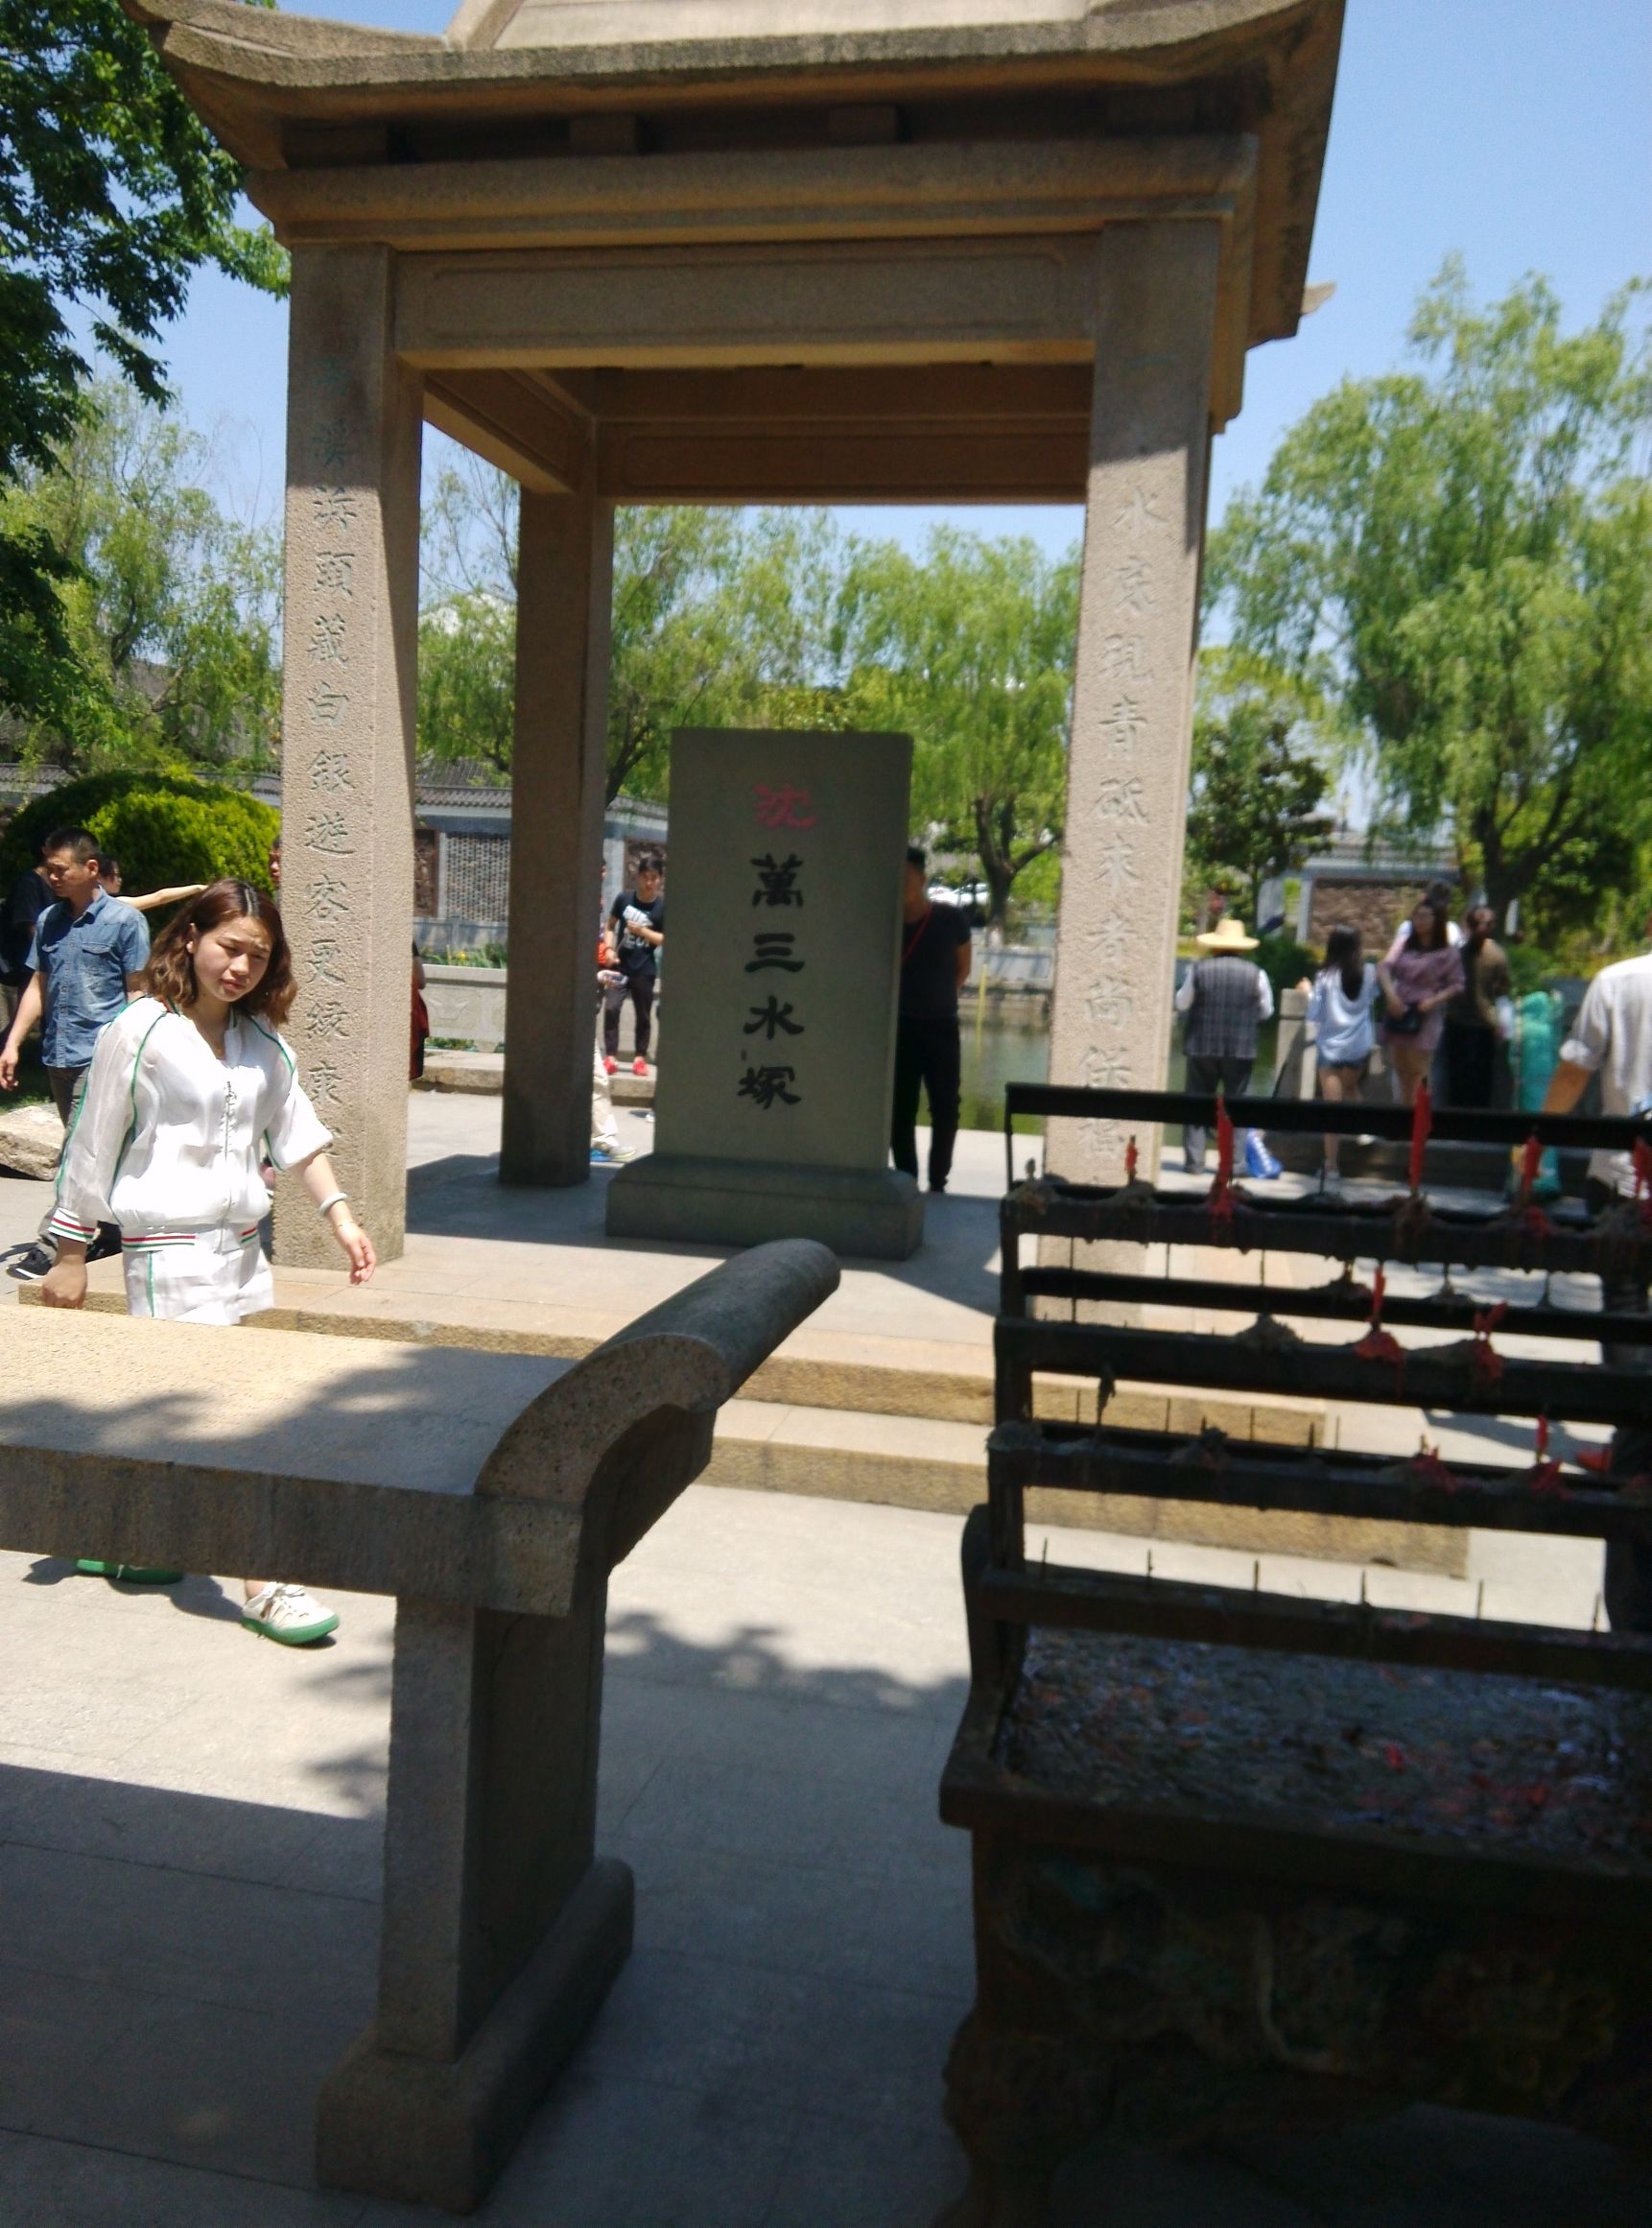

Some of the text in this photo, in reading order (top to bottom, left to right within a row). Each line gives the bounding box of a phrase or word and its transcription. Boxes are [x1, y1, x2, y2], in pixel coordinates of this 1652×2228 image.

[737, 782, 817, 1110] 沈萬三水塚
